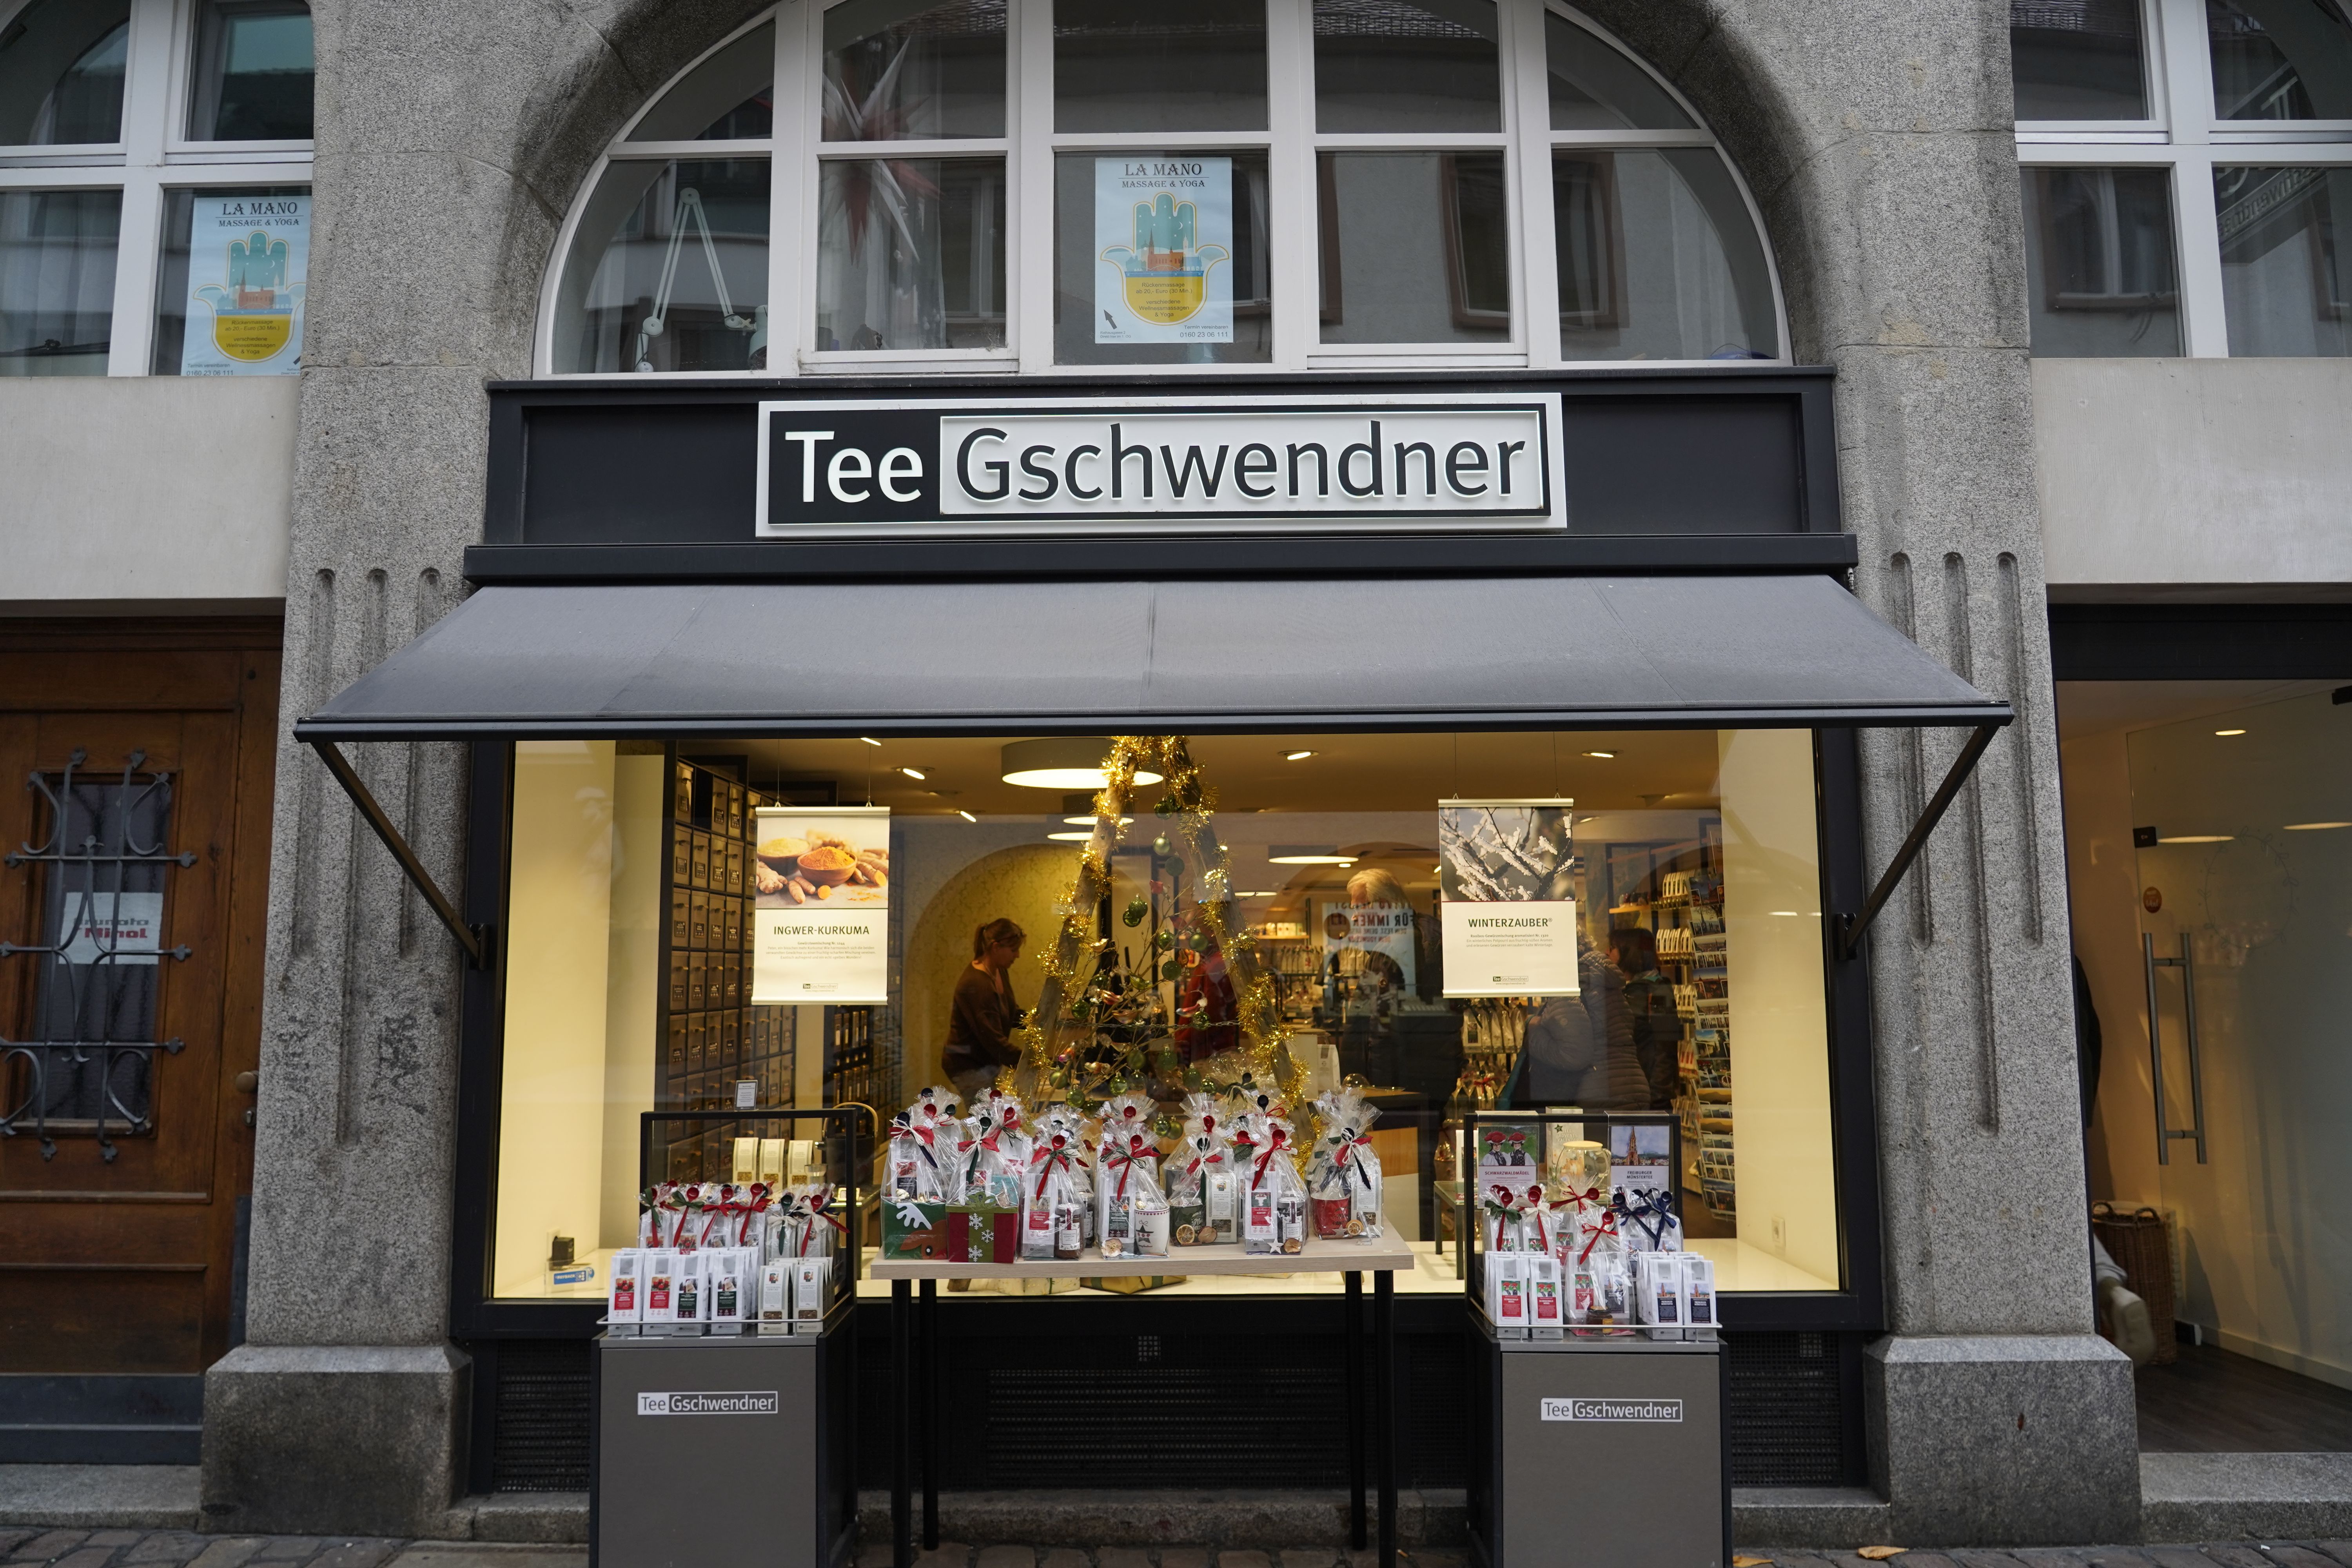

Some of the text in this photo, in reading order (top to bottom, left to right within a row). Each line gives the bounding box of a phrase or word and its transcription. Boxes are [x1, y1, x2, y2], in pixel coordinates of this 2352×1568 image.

[1125, 163, 1203, 176] LA MANO
[223, 202, 298, 216] LA MANO
[275, 218, 299, 226] YOGA
[785, 421, 1526, 504] Tee Gschwendner
[773, 926, 870, 935] INGWER-KURKUMA
[641, 1395, 774, 1412] Tee Gschwendner
[1544, 1401, 1678, 1418] Tee Gschwendner
